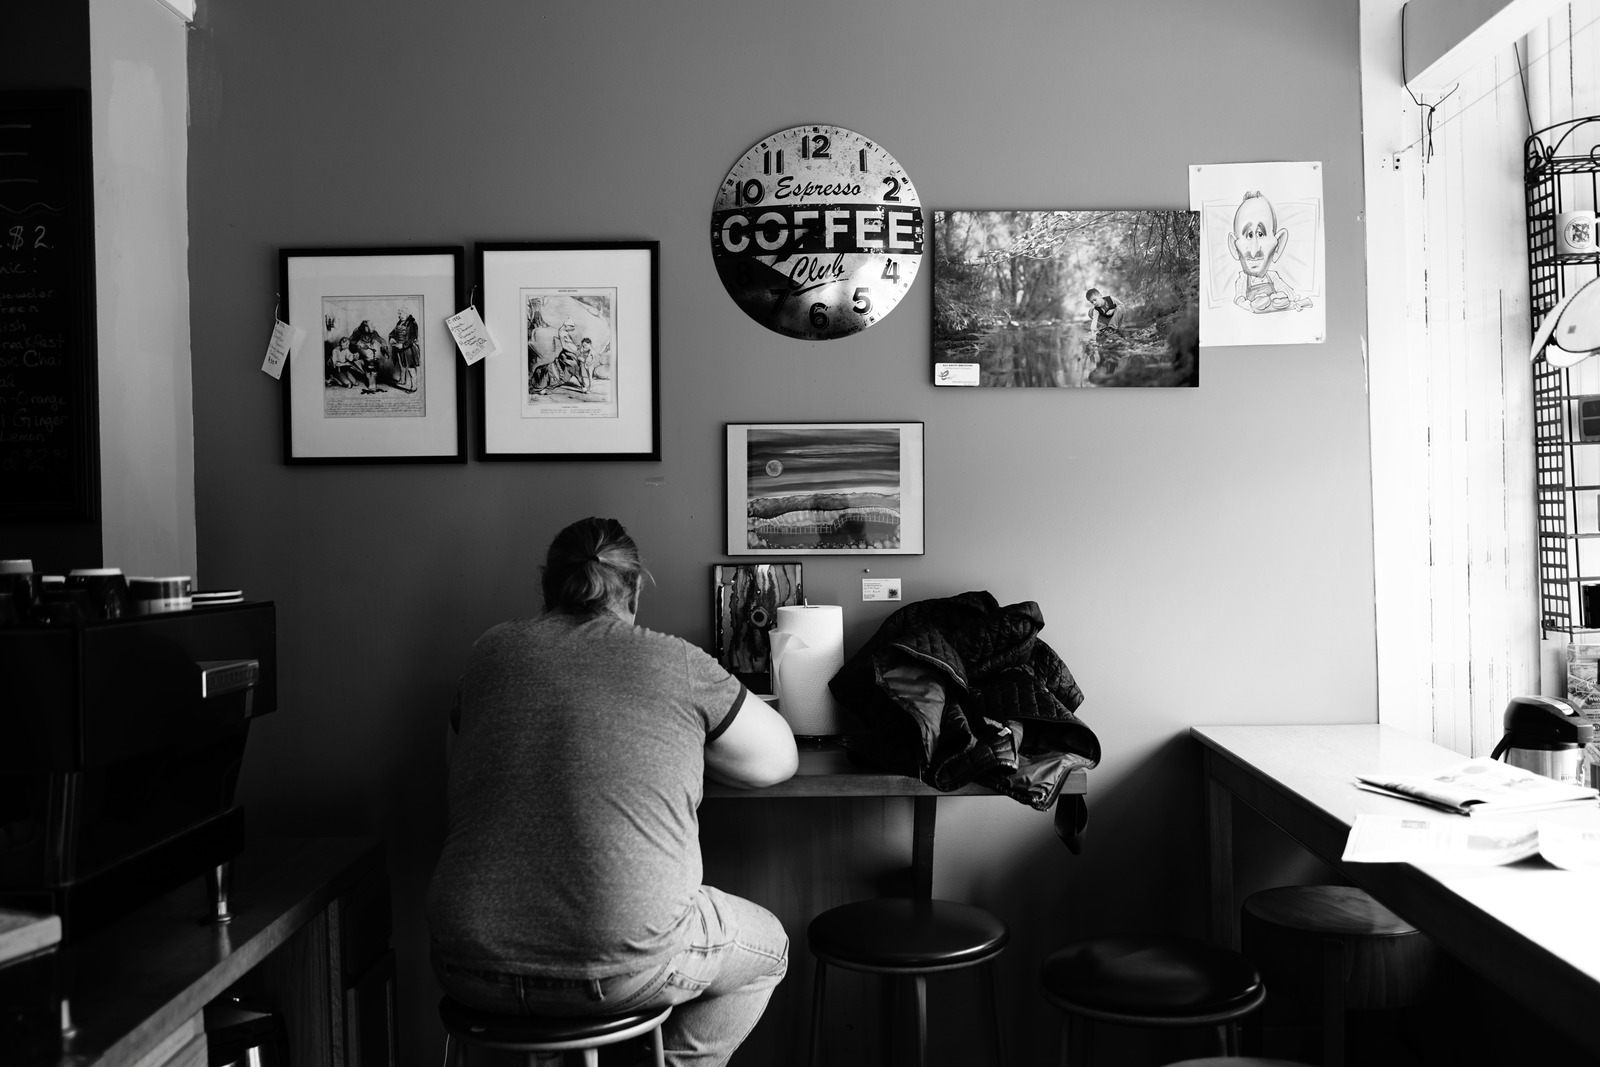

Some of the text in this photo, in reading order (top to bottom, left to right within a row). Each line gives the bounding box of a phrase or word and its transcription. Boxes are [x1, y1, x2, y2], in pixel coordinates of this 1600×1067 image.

[801, 134, 832, 159] 12
[858, 148, 868, 173] 1
[763, 149, 785, 175] 11
[735, 178, 766, 206] 10
[774, 176, 862, 202] Espresso
[882, 176, 902, 203] 2
[721, 210, 915, 253] COFFEE
[788, 253, 846, 291] Club
[880, 257, 901, 285] 4
[769, 287, 791, 316] 7
[852, 286, 873, 315] 5
[808, 302, 830, 330] 6
